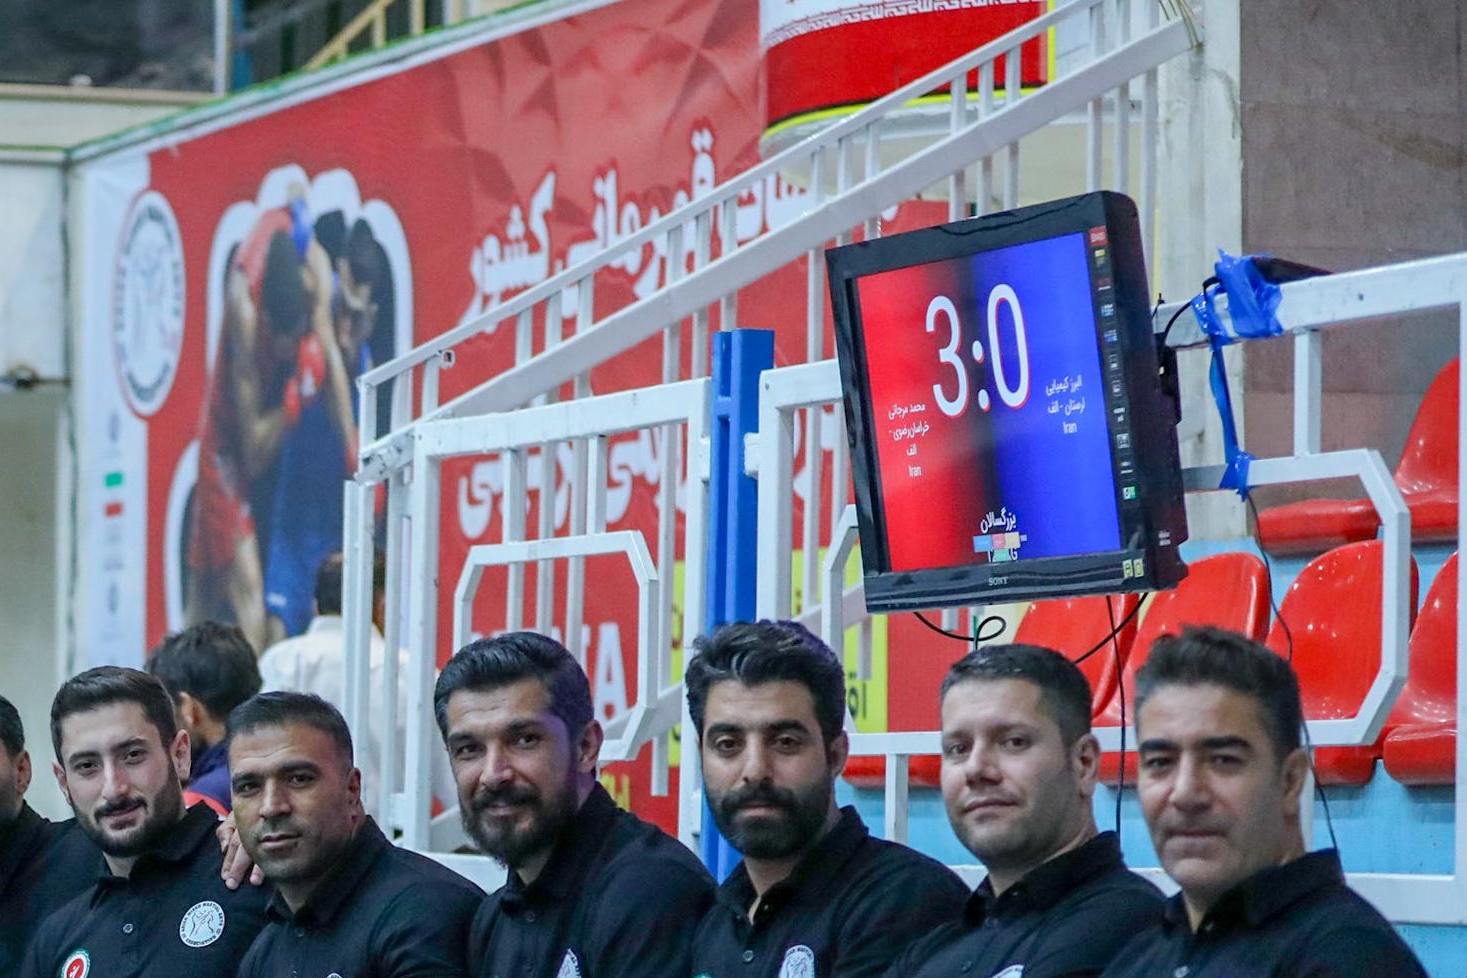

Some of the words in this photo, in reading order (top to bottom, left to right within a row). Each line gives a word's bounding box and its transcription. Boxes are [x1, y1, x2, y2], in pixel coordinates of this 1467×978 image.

[1062, 421, 1078, 434] Iran
[980, 507, 1017, 534] بزرگسالان
[988, 576, 1009, 586] SONY
